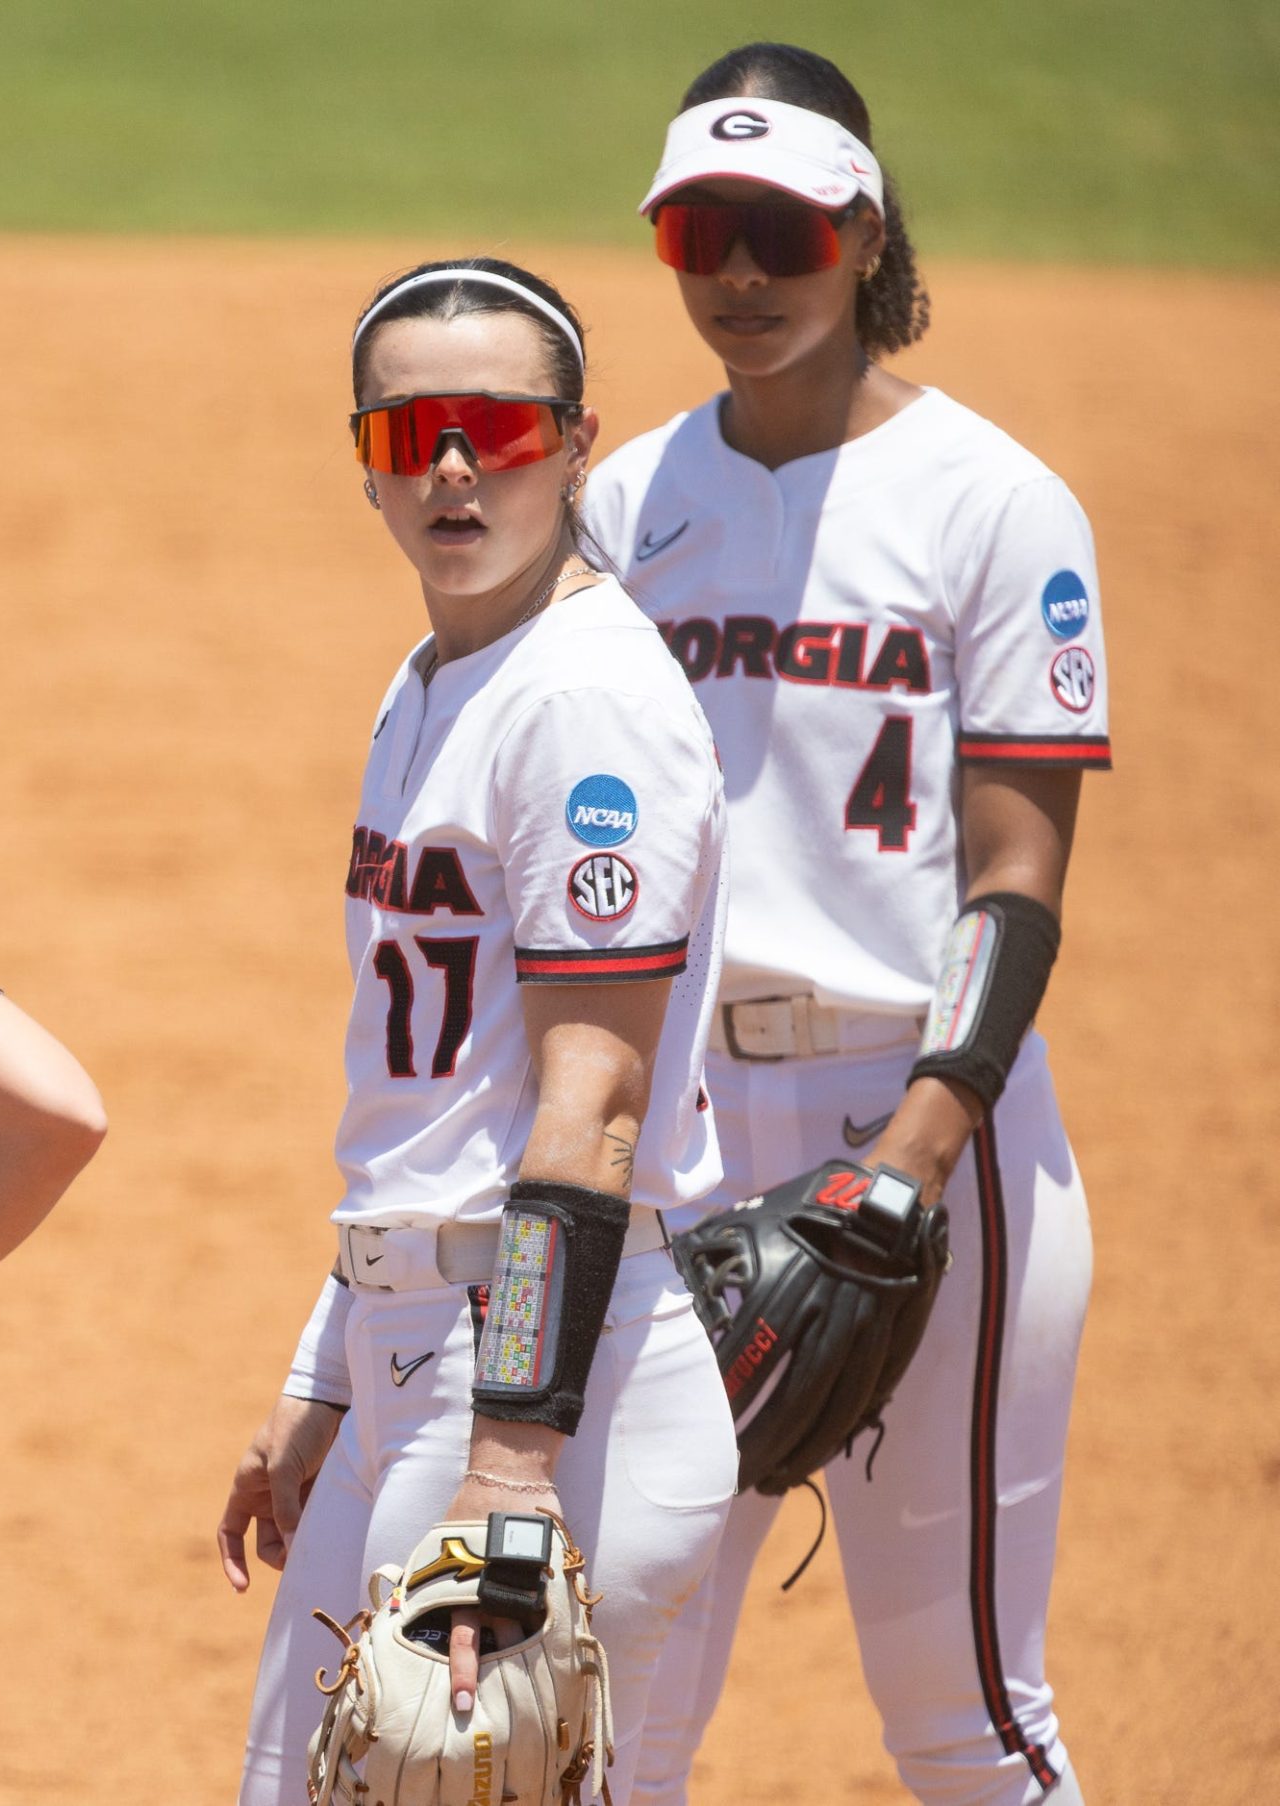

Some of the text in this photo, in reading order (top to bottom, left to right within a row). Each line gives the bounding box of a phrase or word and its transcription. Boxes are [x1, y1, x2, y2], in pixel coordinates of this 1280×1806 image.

[710, 109, 772, 142] G
[1048, 598, 1088, 622] NCAA
[656, 615, 932, 695] ORGIA
[844, 714, 917, 852] 4
[574, 805, 634, 831] NCAA
[571, 855, 634, 918] SEC
[373, 935, 480, 1079] 17
